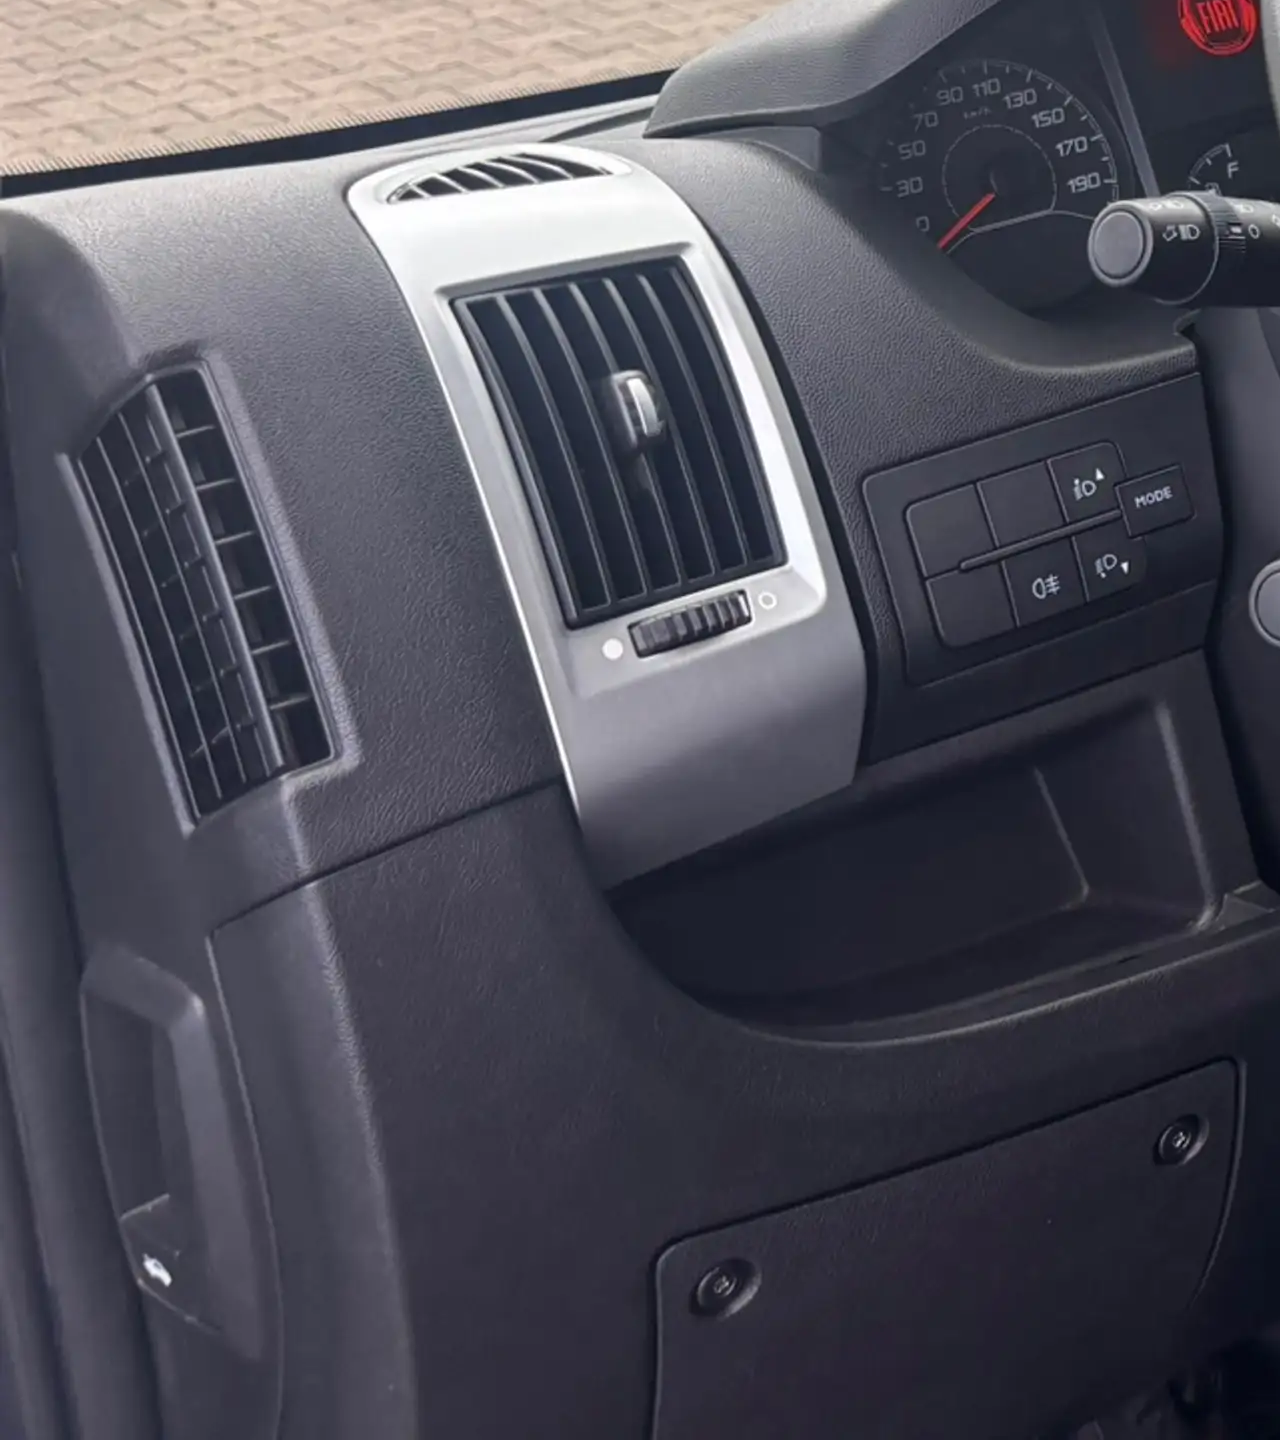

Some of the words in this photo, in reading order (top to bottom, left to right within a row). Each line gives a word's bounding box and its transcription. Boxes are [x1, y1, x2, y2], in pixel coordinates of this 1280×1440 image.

[936, 86, 964, 107] 90
[971, 78, 1000, 98] 110
[1002, 88, 1038, 109] 130
[912, 111, 939, 132] 70
[1030, 108, 1065, 129] 150
[898, 139, 926, 161] 50
[1055, 135, 1088, 158] 170
[1226, 160, 1240, 179] F
[896, 176, 923, 198] 30
[1066, 172, 1101, 194] 190
[1134, 485, 1173, 509] MODE
